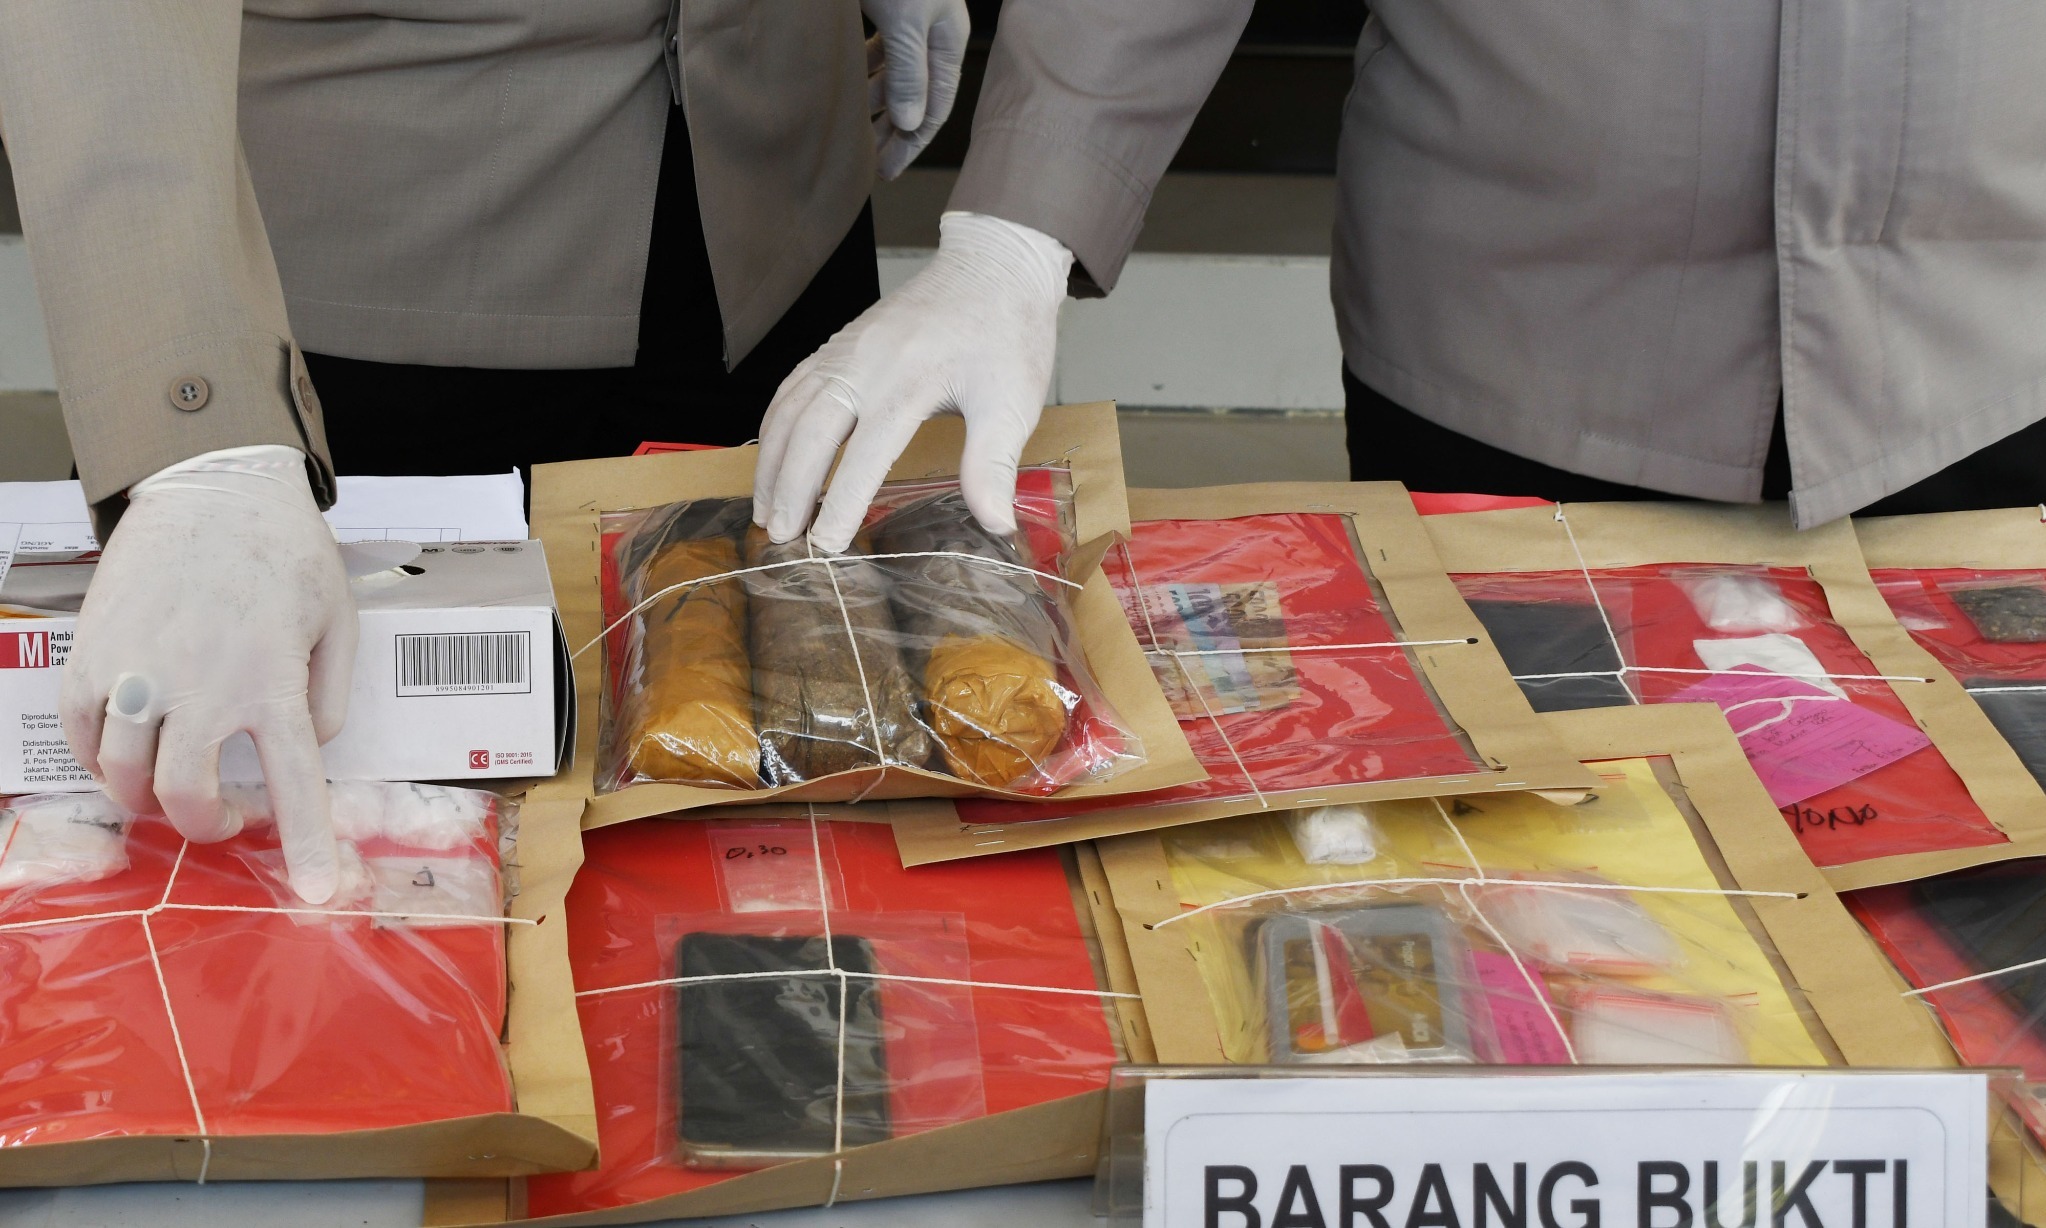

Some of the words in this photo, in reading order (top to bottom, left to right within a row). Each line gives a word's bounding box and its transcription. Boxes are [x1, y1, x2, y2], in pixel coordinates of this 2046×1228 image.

[50, 631, 74, 641] Ambi
[18, 632, 44, 667] M
[50, 643, 72, 653] Pow
[51, 656, 68, 666] Lat
[21, 713, 59, 721] Diproduksi
[22, 722, 36, 730] Top
[23, 774, 67, 782] KEMENKES
[1204, 1160, 1600, 1228] BARANG
[1637, 1159, 1907, 1228] BUKTI
